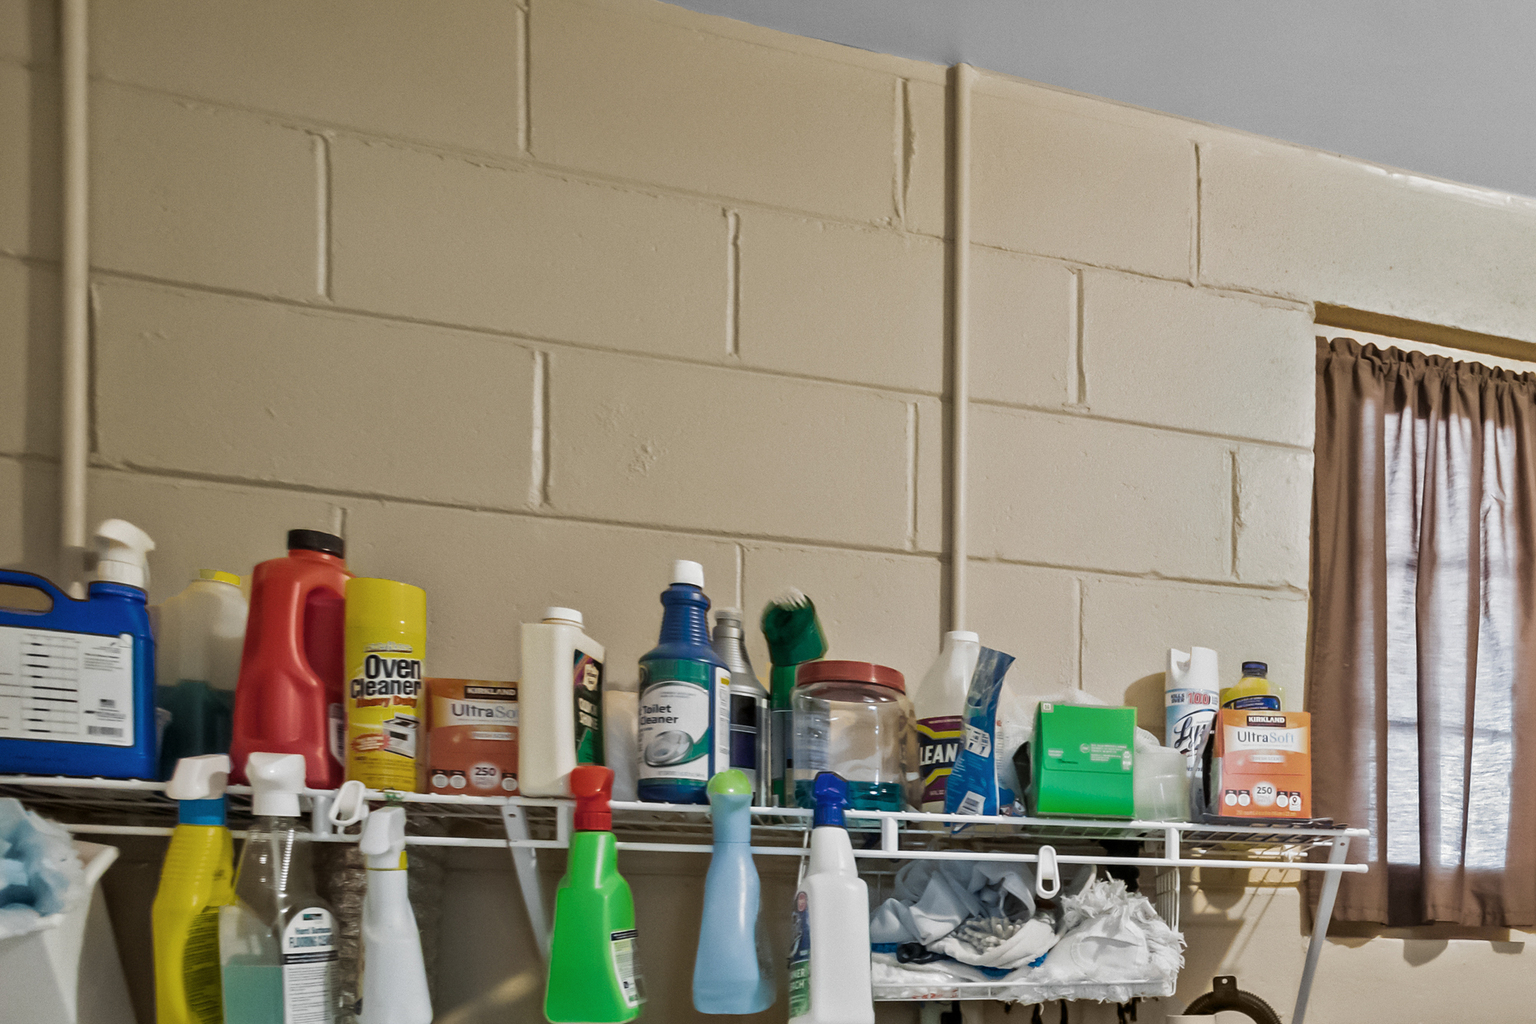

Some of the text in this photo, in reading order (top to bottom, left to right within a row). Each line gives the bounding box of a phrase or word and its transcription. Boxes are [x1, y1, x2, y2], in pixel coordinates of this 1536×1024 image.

[365, 654, 421, 679] Oven
[351, 678, 421, 698] Cleaner
[642, 704, 672, 714] Toilet
[1248, 716, 1286, 724] KIRKLAND
[1237, 731, 1294, 743] UltraSoft
[920, 743, 958, 766] LEAN
[475, 767, 496, 776] 250
[1256, 786, 1272, 794] 250
